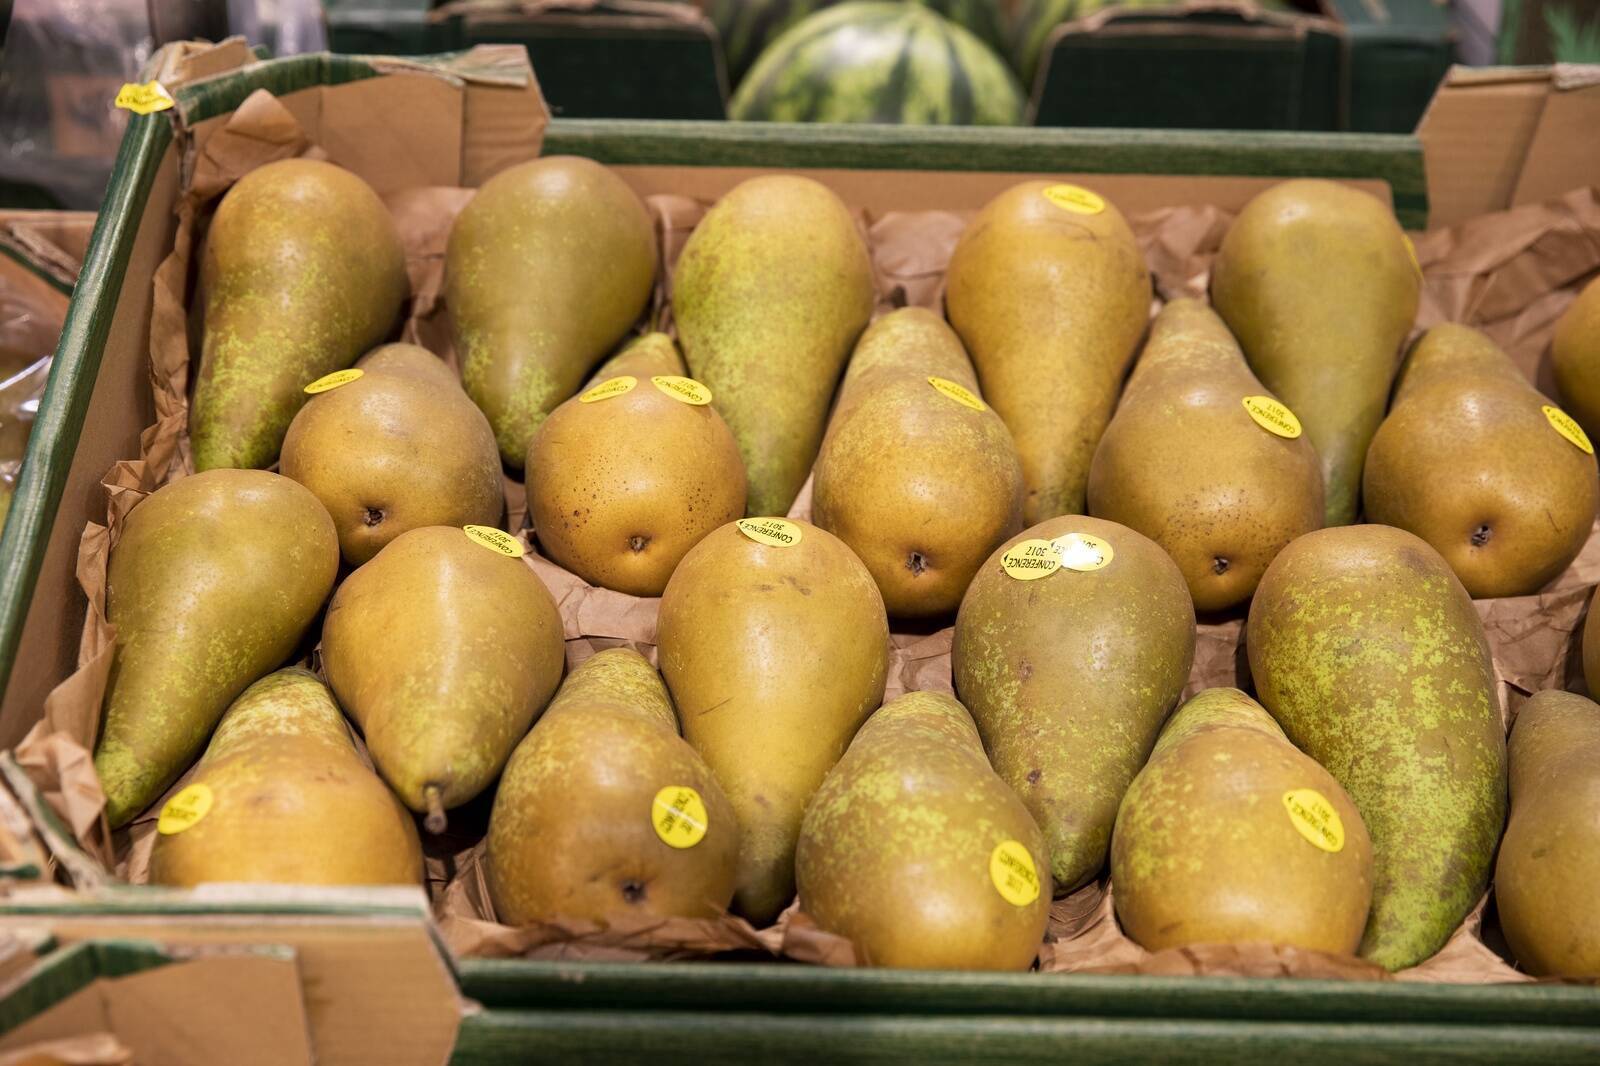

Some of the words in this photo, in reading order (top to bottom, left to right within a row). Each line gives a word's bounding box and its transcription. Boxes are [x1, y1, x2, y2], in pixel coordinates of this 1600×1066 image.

[762, 521, 785, 531] 3017
[742, 522, 793, 544] CONFERENCE
[467, 529, 513, 553] CONFERENCE
[1025, 546, 1048, 557] 3017
[1006, 557, 1056, 570] CONFERENCE
